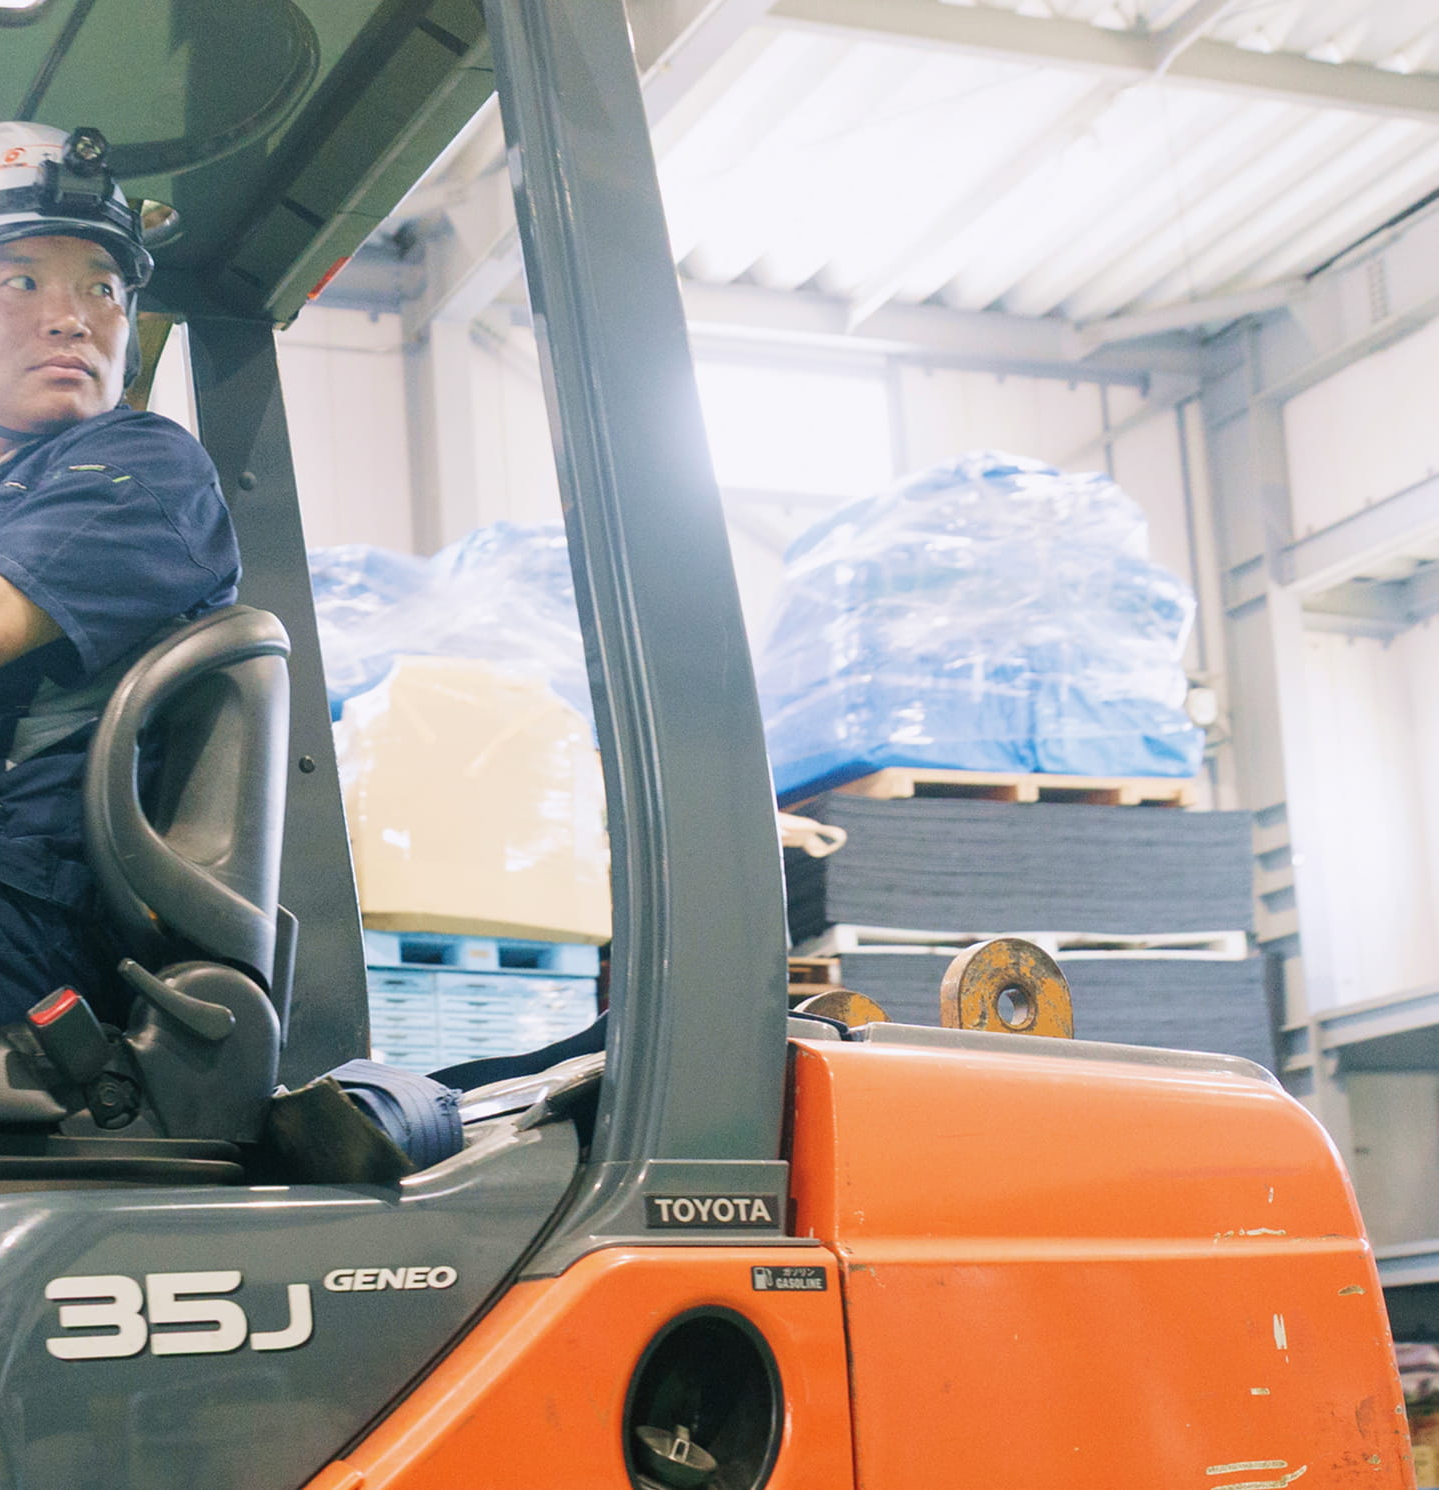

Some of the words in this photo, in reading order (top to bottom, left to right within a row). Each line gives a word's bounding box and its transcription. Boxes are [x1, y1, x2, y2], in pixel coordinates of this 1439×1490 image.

[654, 1199, 772, 1222] TOYOTA
[324, 1266, 457, 1291] GENEO
[776, 1278, 823, 1289] GASOLINE
